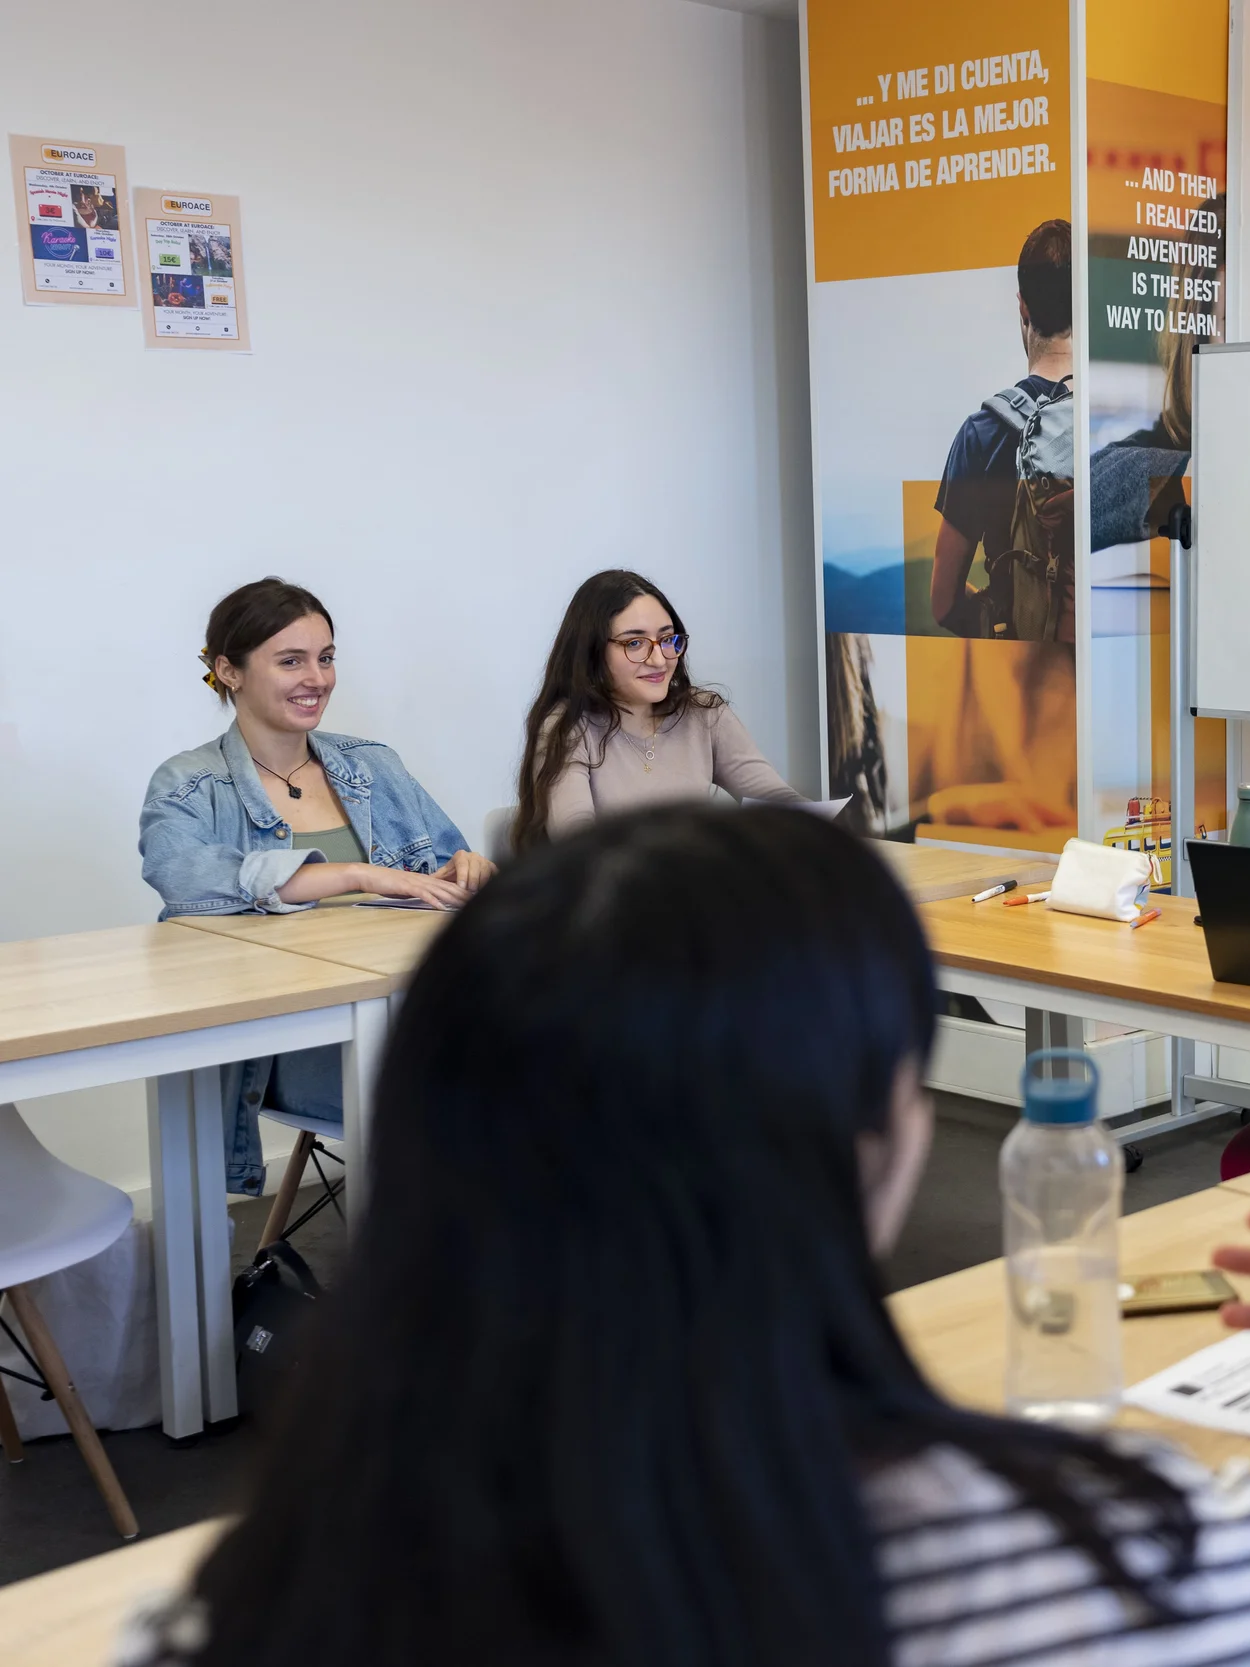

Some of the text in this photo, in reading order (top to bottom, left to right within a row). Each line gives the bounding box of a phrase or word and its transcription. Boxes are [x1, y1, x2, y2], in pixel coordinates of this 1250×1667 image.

[877, 74, 892, 102] Y
[897, 68, 928, 100] ME
[934, 64, 955, 94] DI
[961, 49, 1049, 90] CUENTA,
[832, 96, 1049, 154] VIAJAR ES LA MEJOR
[51, 150, 94, 161] EUROACE
[828, 143, 1056, 198] FORMA DE APRENDER.
[1142, 167, 1174, 193] AND
[1178, 172, 1217, 200] THEN
[171, 201, 210, 210] EUROACE
[1136, 201, 1222, 239] I REALIZED,
[41, 232, 76, 244] Karaoke
[1127, 236, 1217, 268] ADVENTURE
[1132, 272, 1221, 302] IS THE BEST
[1106, 304, 1221, 336] WAY TO LEARN.
